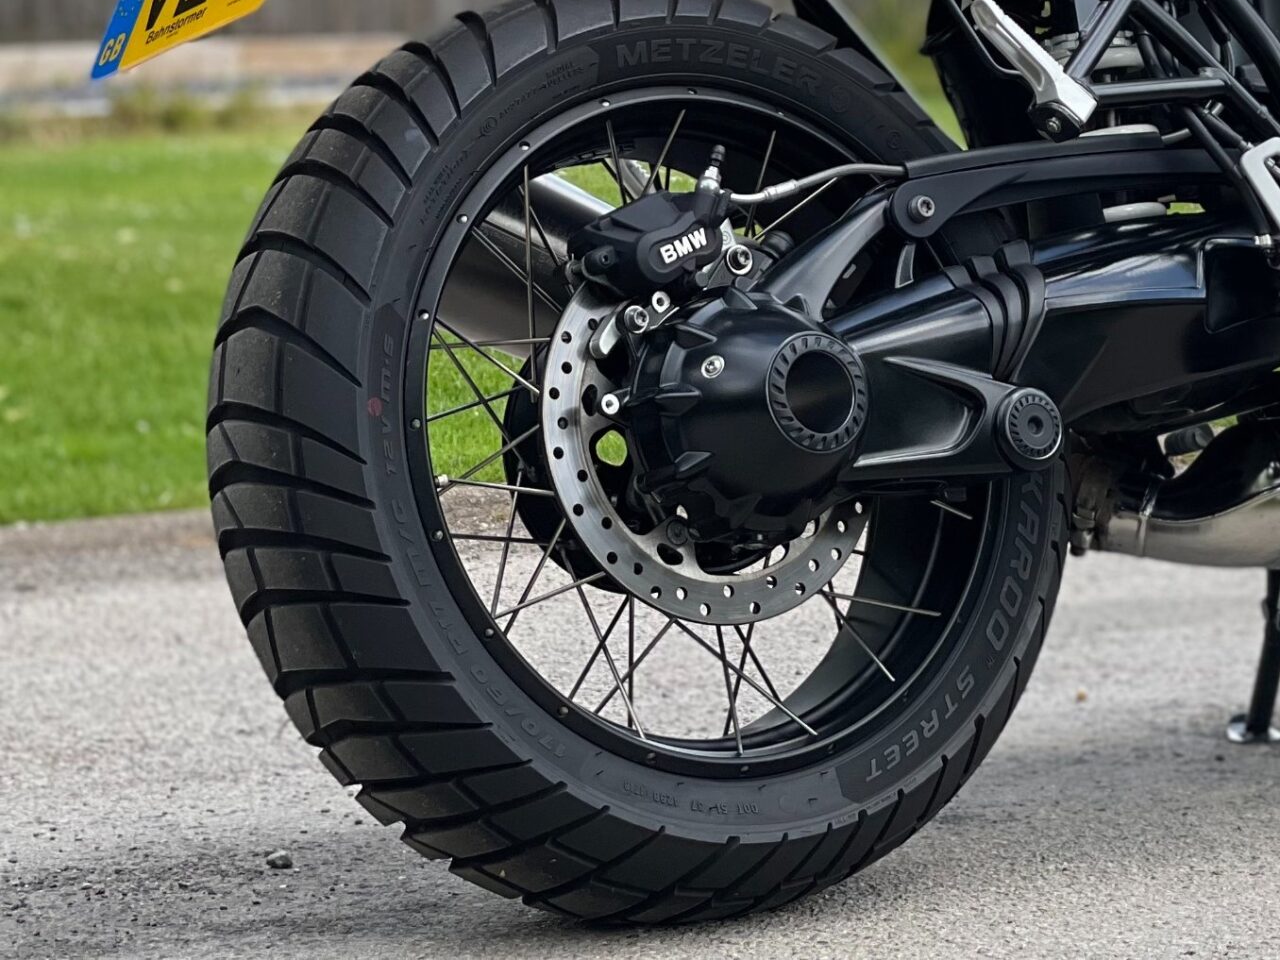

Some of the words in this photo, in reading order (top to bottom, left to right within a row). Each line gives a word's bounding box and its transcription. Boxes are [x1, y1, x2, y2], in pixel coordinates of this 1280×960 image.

[99, 32, 126, 66] GB
[145, 7, 208, 45] Bahnstormer
[616, 38, 825, 98] METZELER
[659, 227, 708, 265] BMW
[985, 472, 1046, 651] KAROO
[865, 666, 976, 783] STREET
